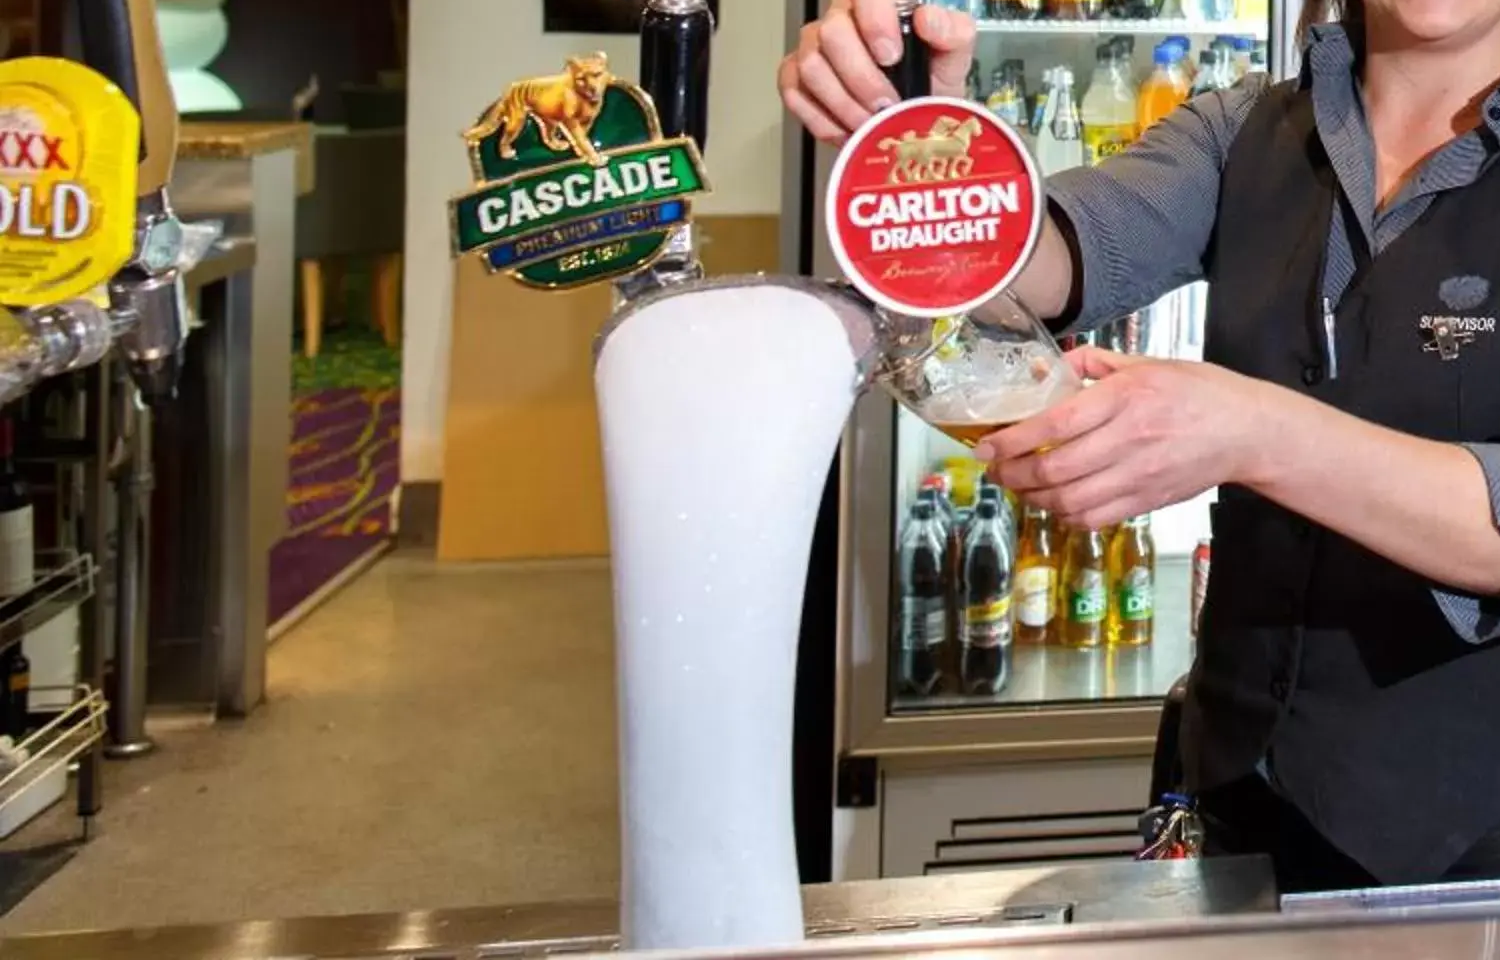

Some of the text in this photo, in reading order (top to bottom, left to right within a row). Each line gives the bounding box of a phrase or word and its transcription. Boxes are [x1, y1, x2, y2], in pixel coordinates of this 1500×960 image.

[477, 155, 679, 234] CASCADE
[848, 180, 1021, 228] CARLTON
[871, 217, 1001, 253] DRAUGHT
[1420, 315, 1497, 333] SUVISOR
